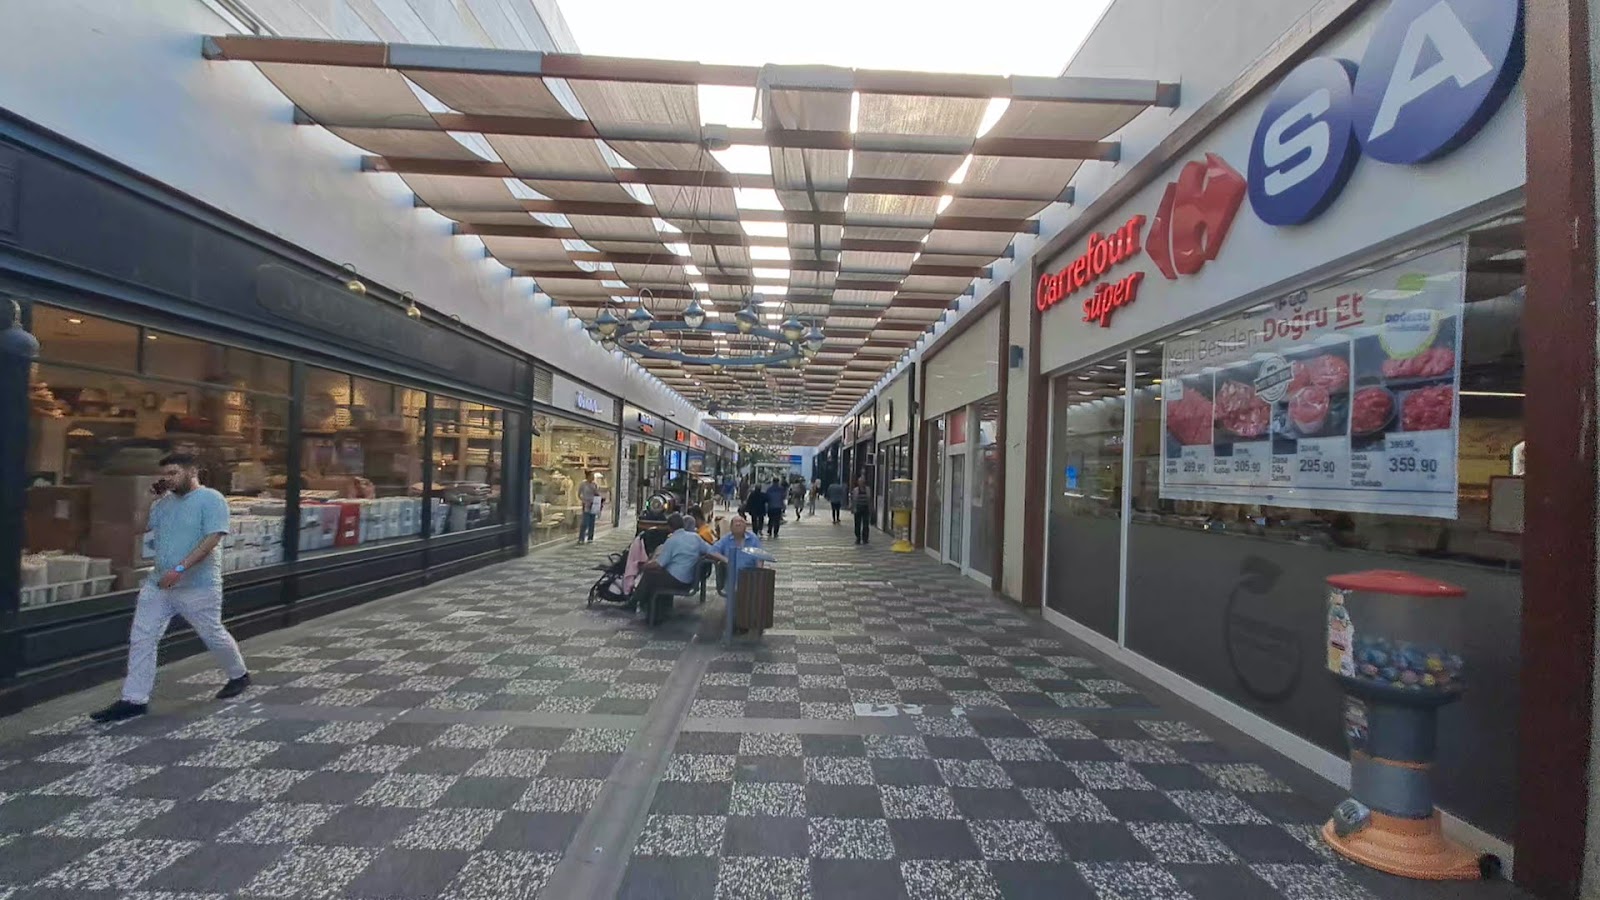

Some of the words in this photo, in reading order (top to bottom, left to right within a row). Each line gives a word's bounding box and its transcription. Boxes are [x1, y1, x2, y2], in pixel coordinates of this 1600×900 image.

[1036, 214, 1147, 312] Carrefour
[1199, 325, 1260, 361] Besiden
[1263, 306, 1328, 342] Doğru
[1335, 291, 1365, 324] Et
